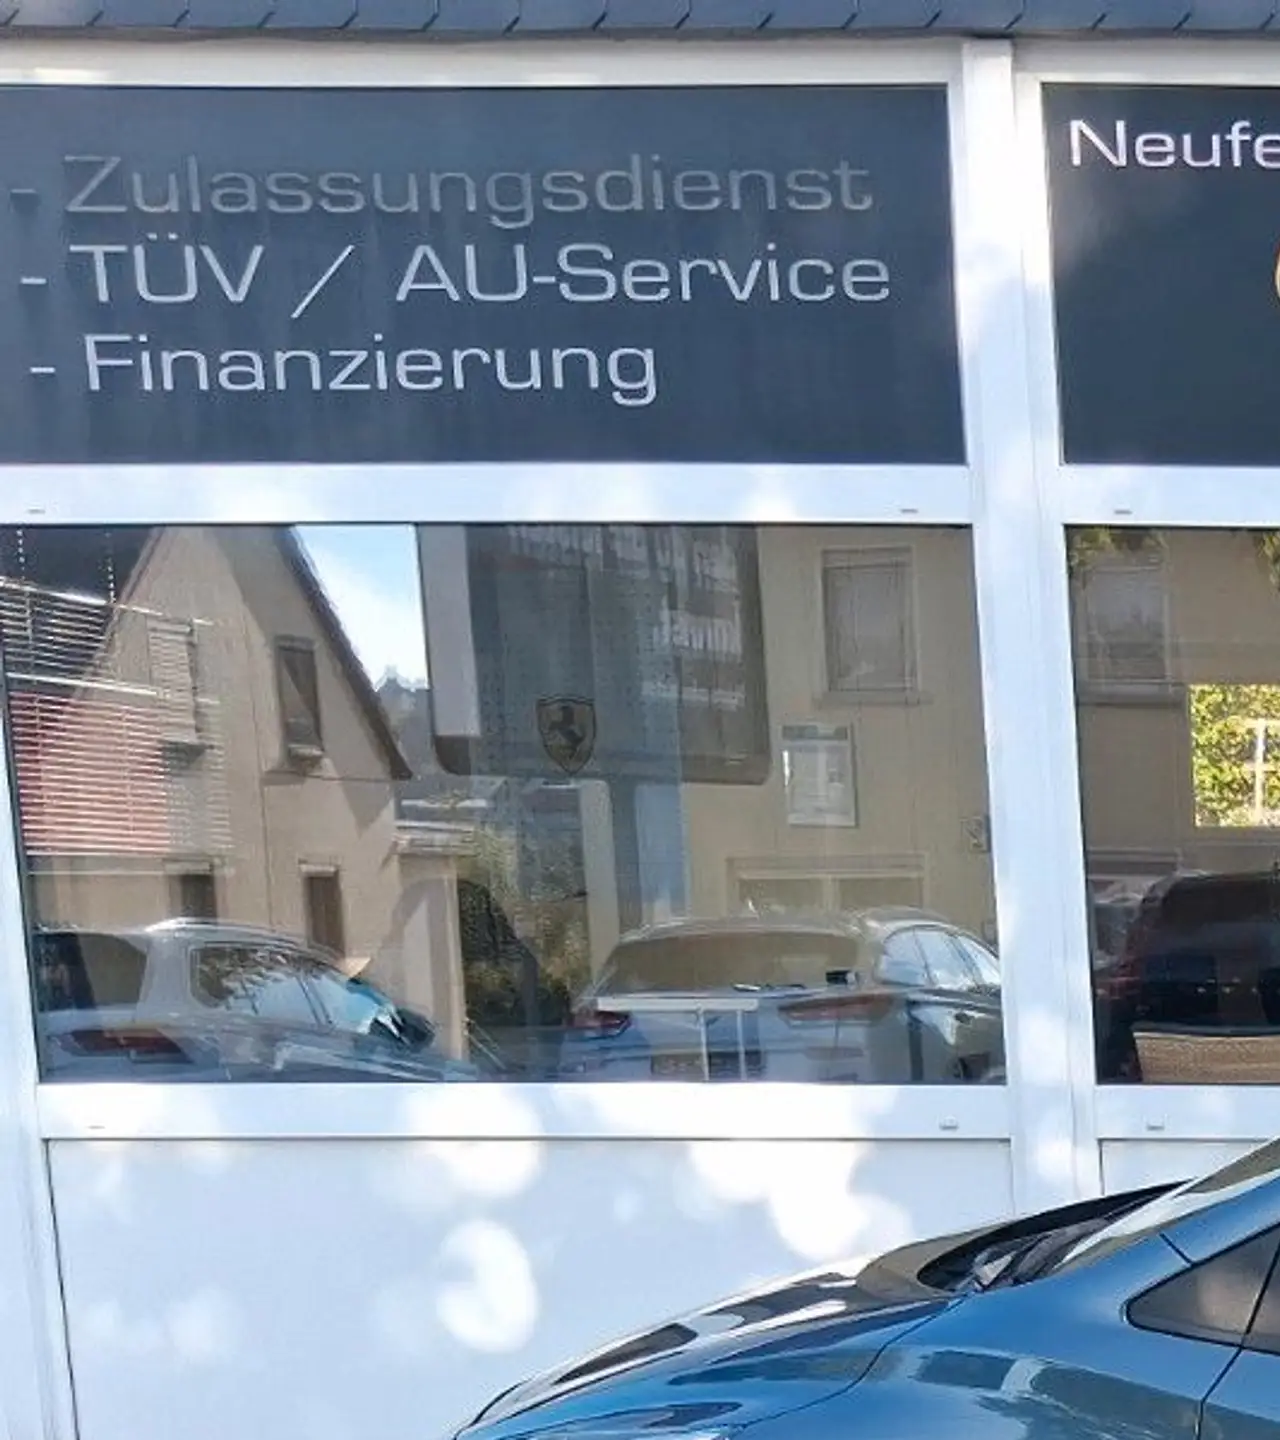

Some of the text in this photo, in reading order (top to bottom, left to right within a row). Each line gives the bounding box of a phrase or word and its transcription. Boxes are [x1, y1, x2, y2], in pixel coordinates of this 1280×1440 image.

[64, 153, 874, 229] Zulassungsdienst
[69, 232, 264, 303] TÜV
[290, 244, 355, 319] /
[396, 242, 891, 302] AU-Service
[84, 334, 658, 406] Finanzierung
